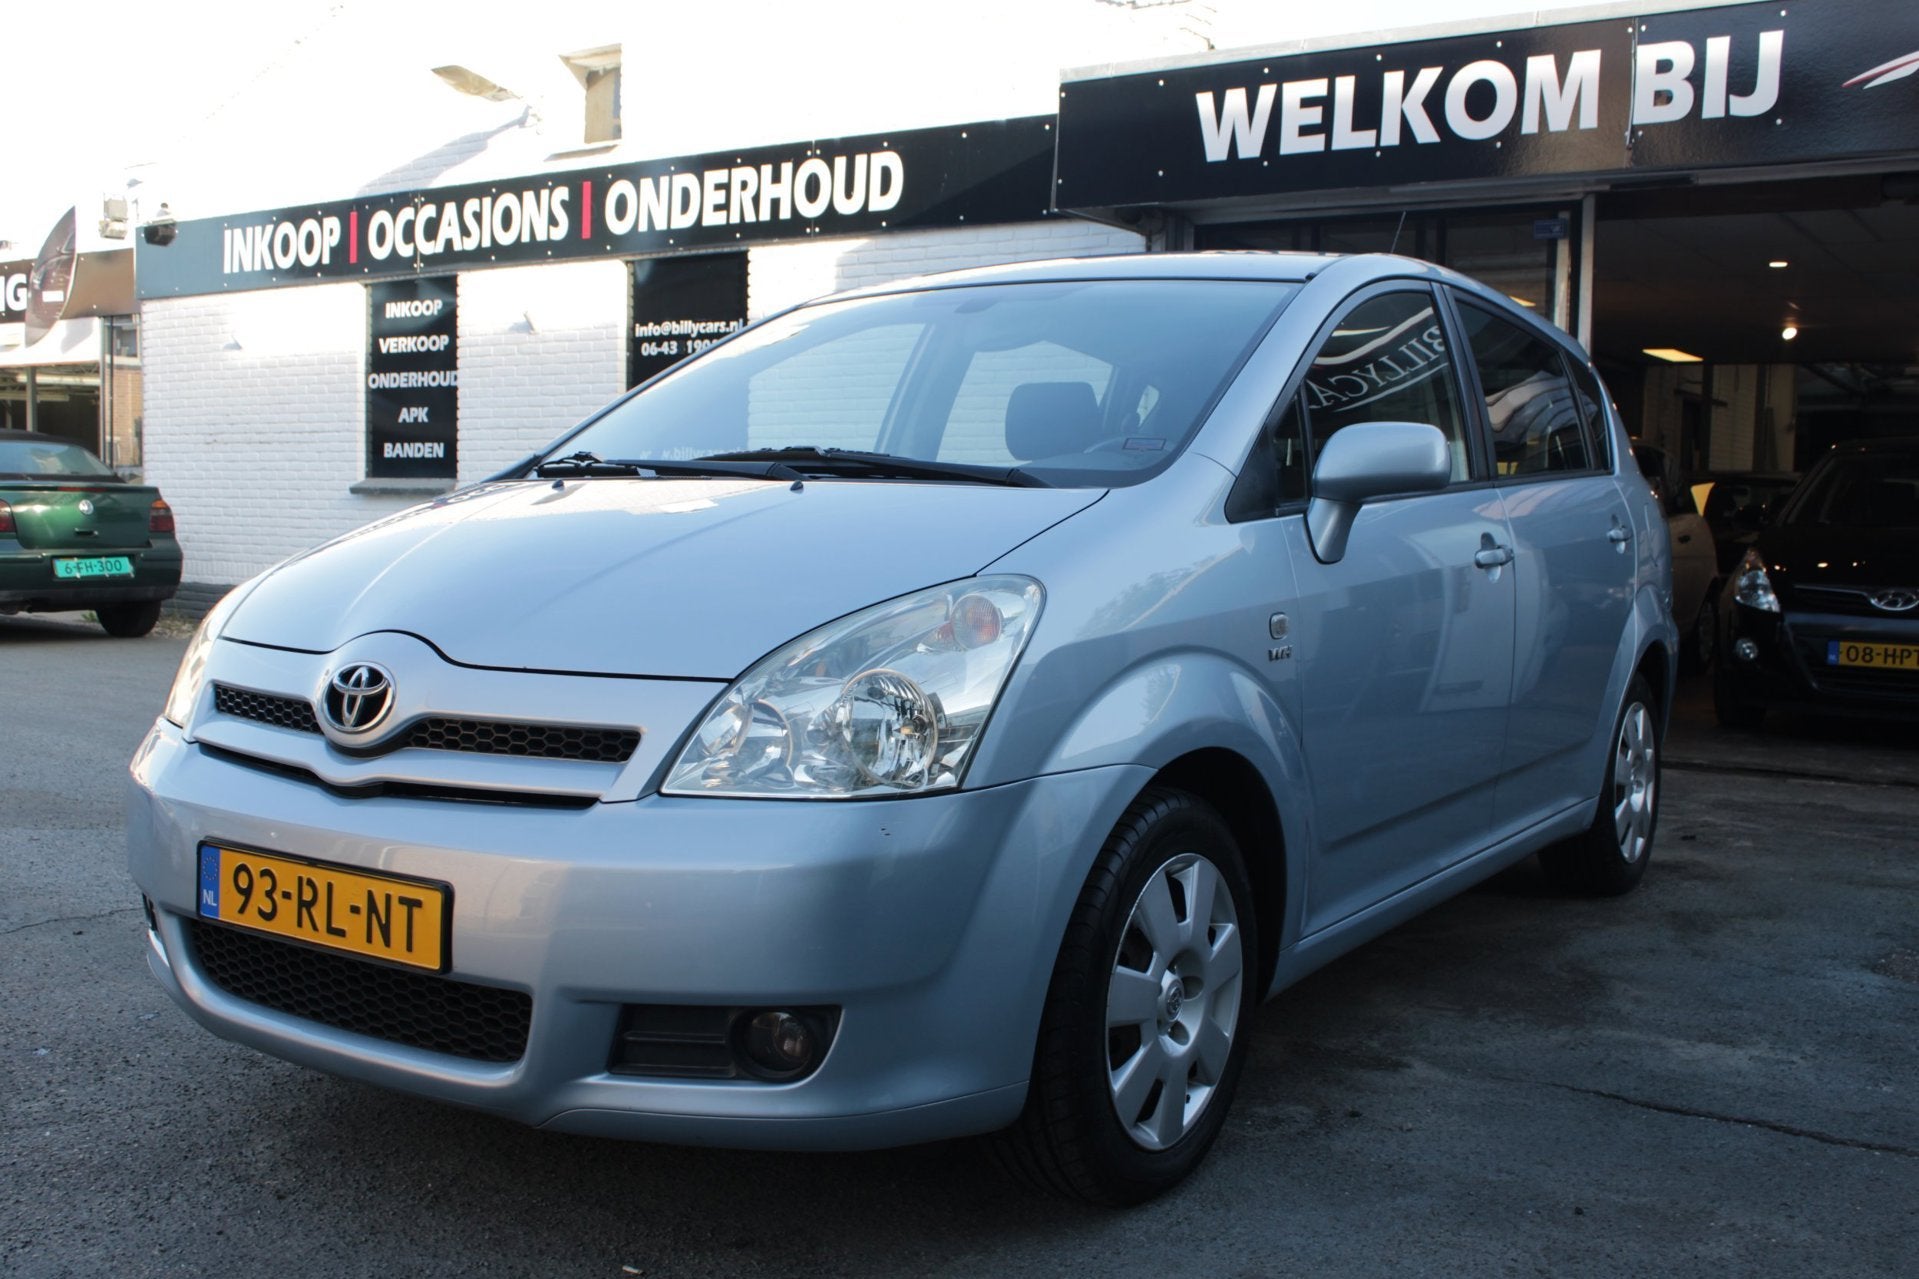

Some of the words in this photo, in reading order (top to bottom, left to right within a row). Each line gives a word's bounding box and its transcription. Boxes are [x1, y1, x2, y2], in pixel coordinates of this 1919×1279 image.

[1195, 49, 1602, 163] WELKOM
[1632, 30, 1784, 125] BIJ
[223, 216, 342, 274] INKOOP
[367, 186, 570, 261] OCCASIONS
[605, 151, 905, 236] ONDERHOUD
[385, 300, 443, 319] INKOOP
[635, 319, 744, 338] info@billycars.nl
[379, 335, 449, 354] VERKOOP
[641, 341, 678, 356] 06-43
[368, 371, 458, 389] ONDERHOUD
[398, 407, 429, 423] APK
[384, 442, 444, 458] BANDEN
[65, 560, 123, 575] 6-FH-300
[203, 888, 218, 908] NL
[233, 863, 423, 953] 93-RL-NT
